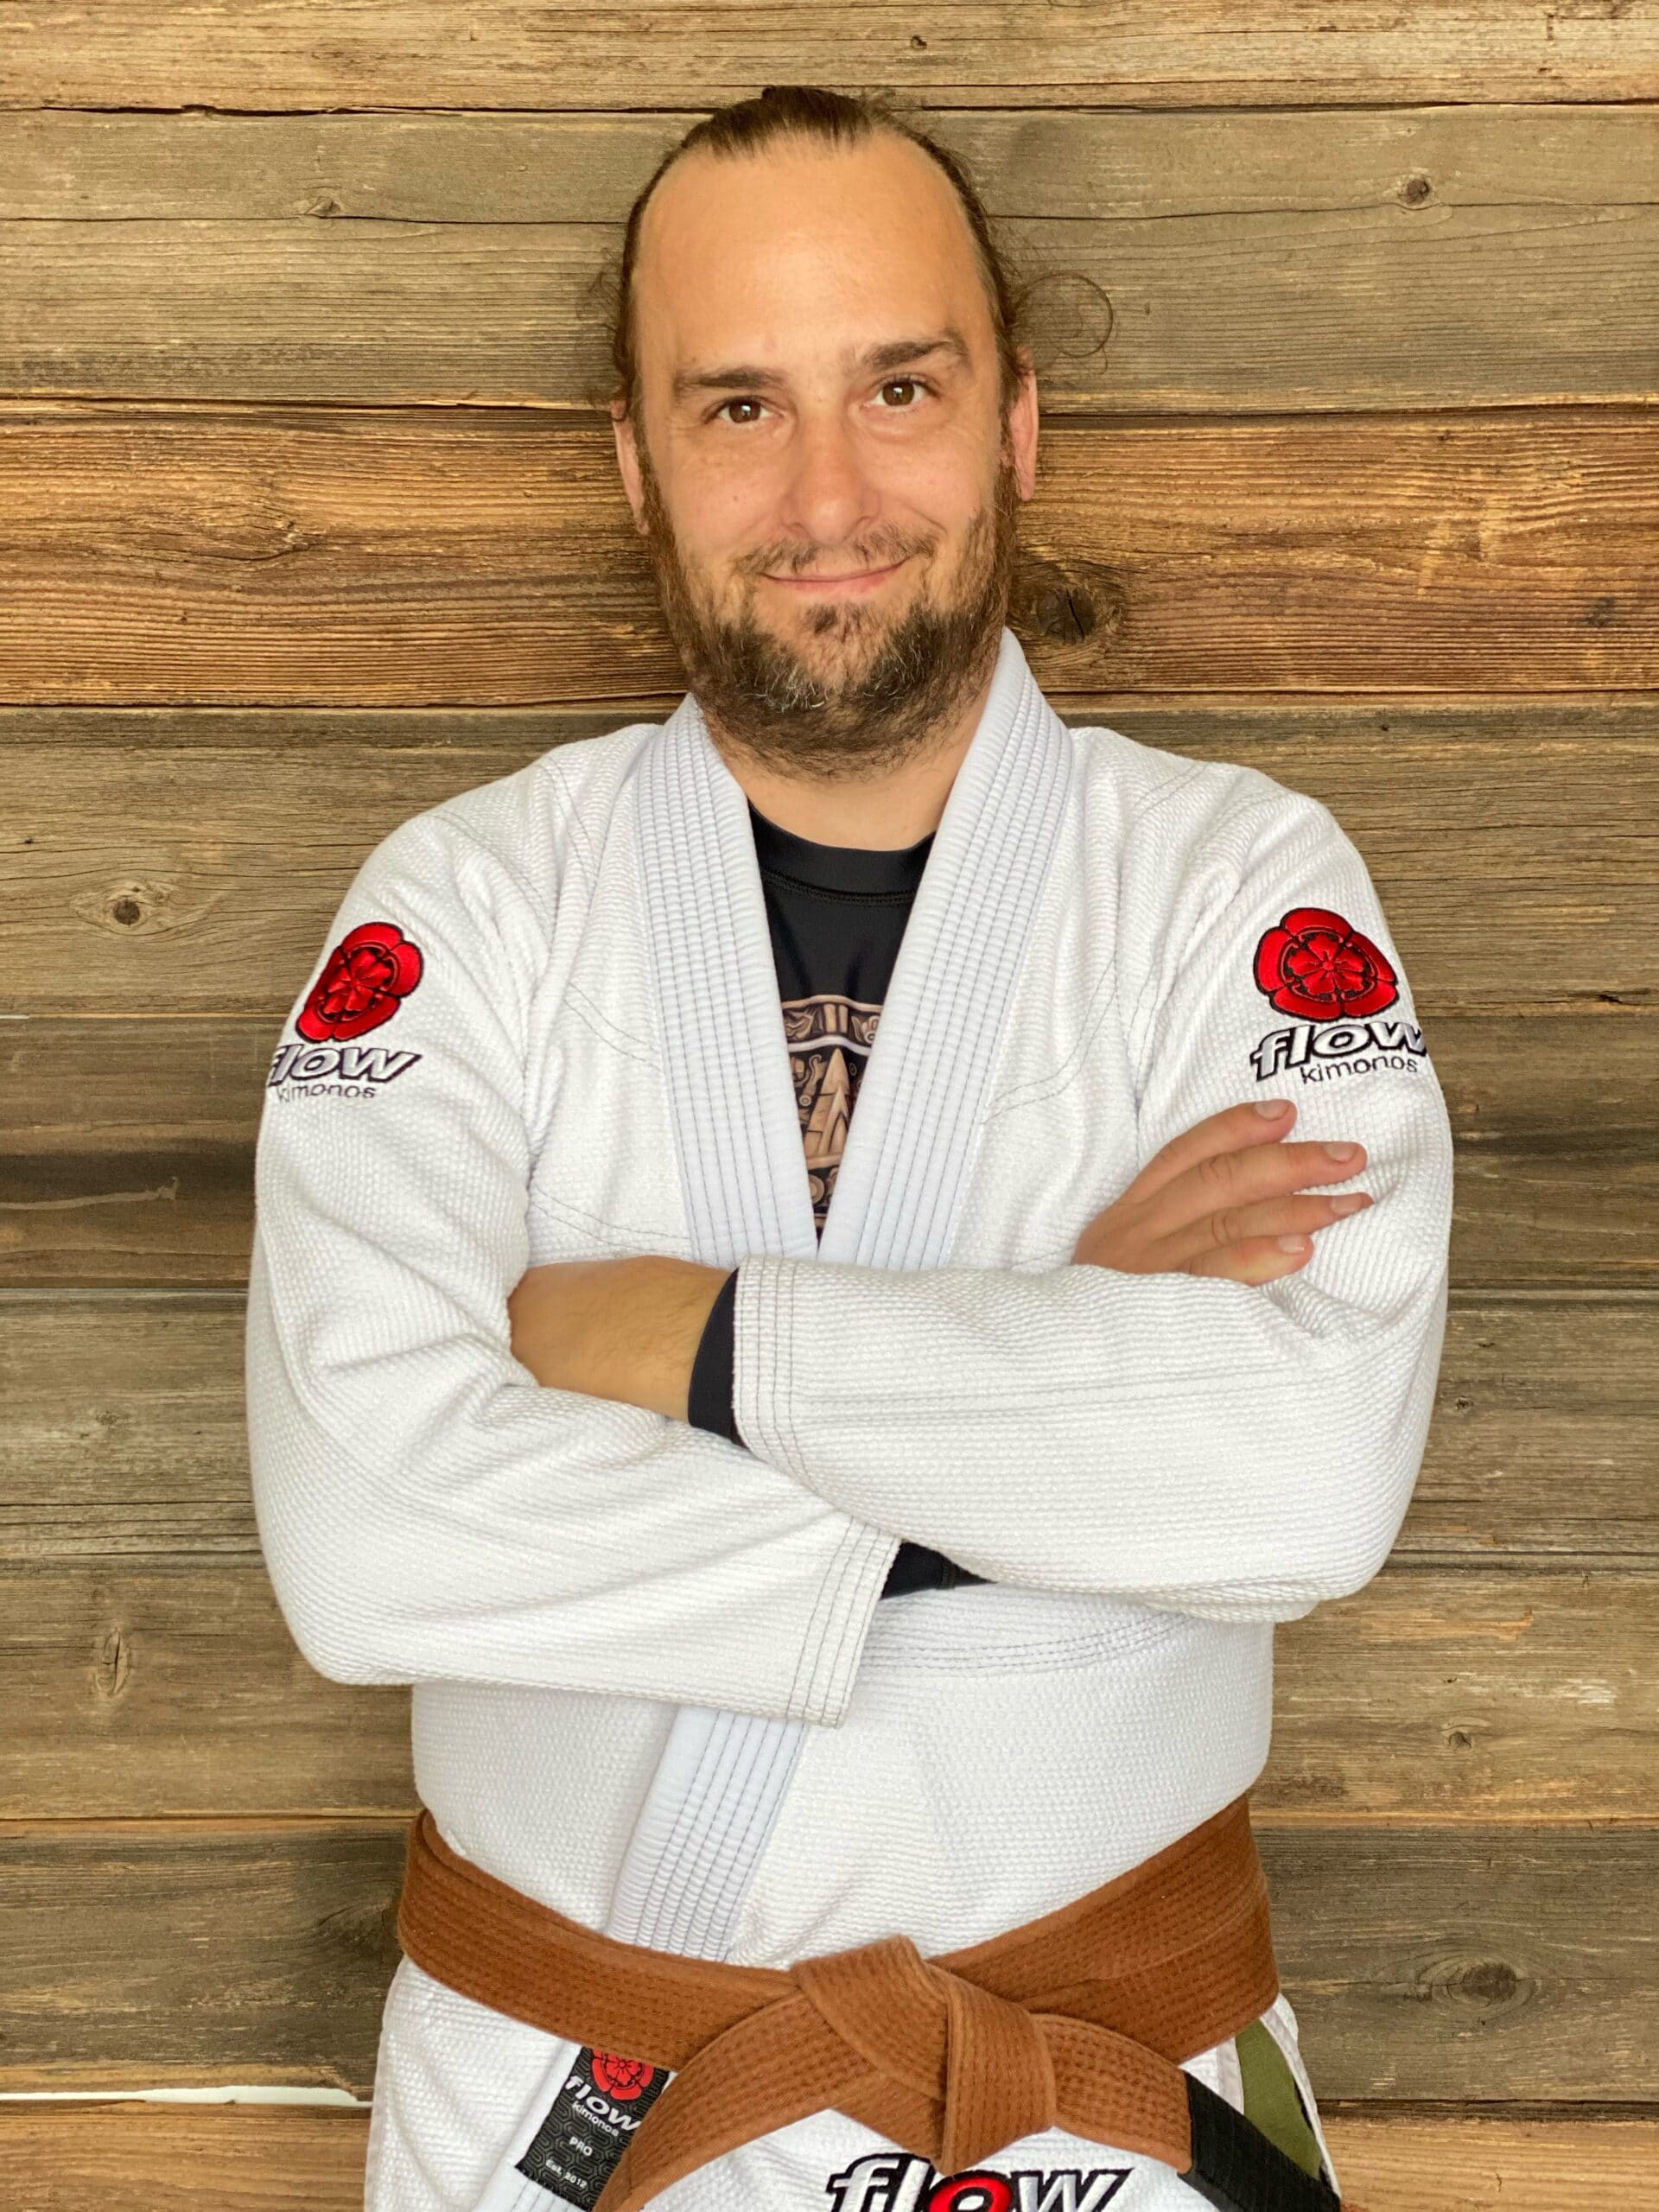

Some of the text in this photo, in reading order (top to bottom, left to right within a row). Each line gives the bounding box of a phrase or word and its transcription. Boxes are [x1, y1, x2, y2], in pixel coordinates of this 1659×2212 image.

[1300, 1055, 1418, 1084] kimonos
[276, 1084, 377, 1103] kimonos
[565, 2075, 641, 2131] flow
[572, 2101, 620, 2137] kimonos
[569, 2136, 593, 2157] PRO
[563, 2172, 588, 2189] 2012
